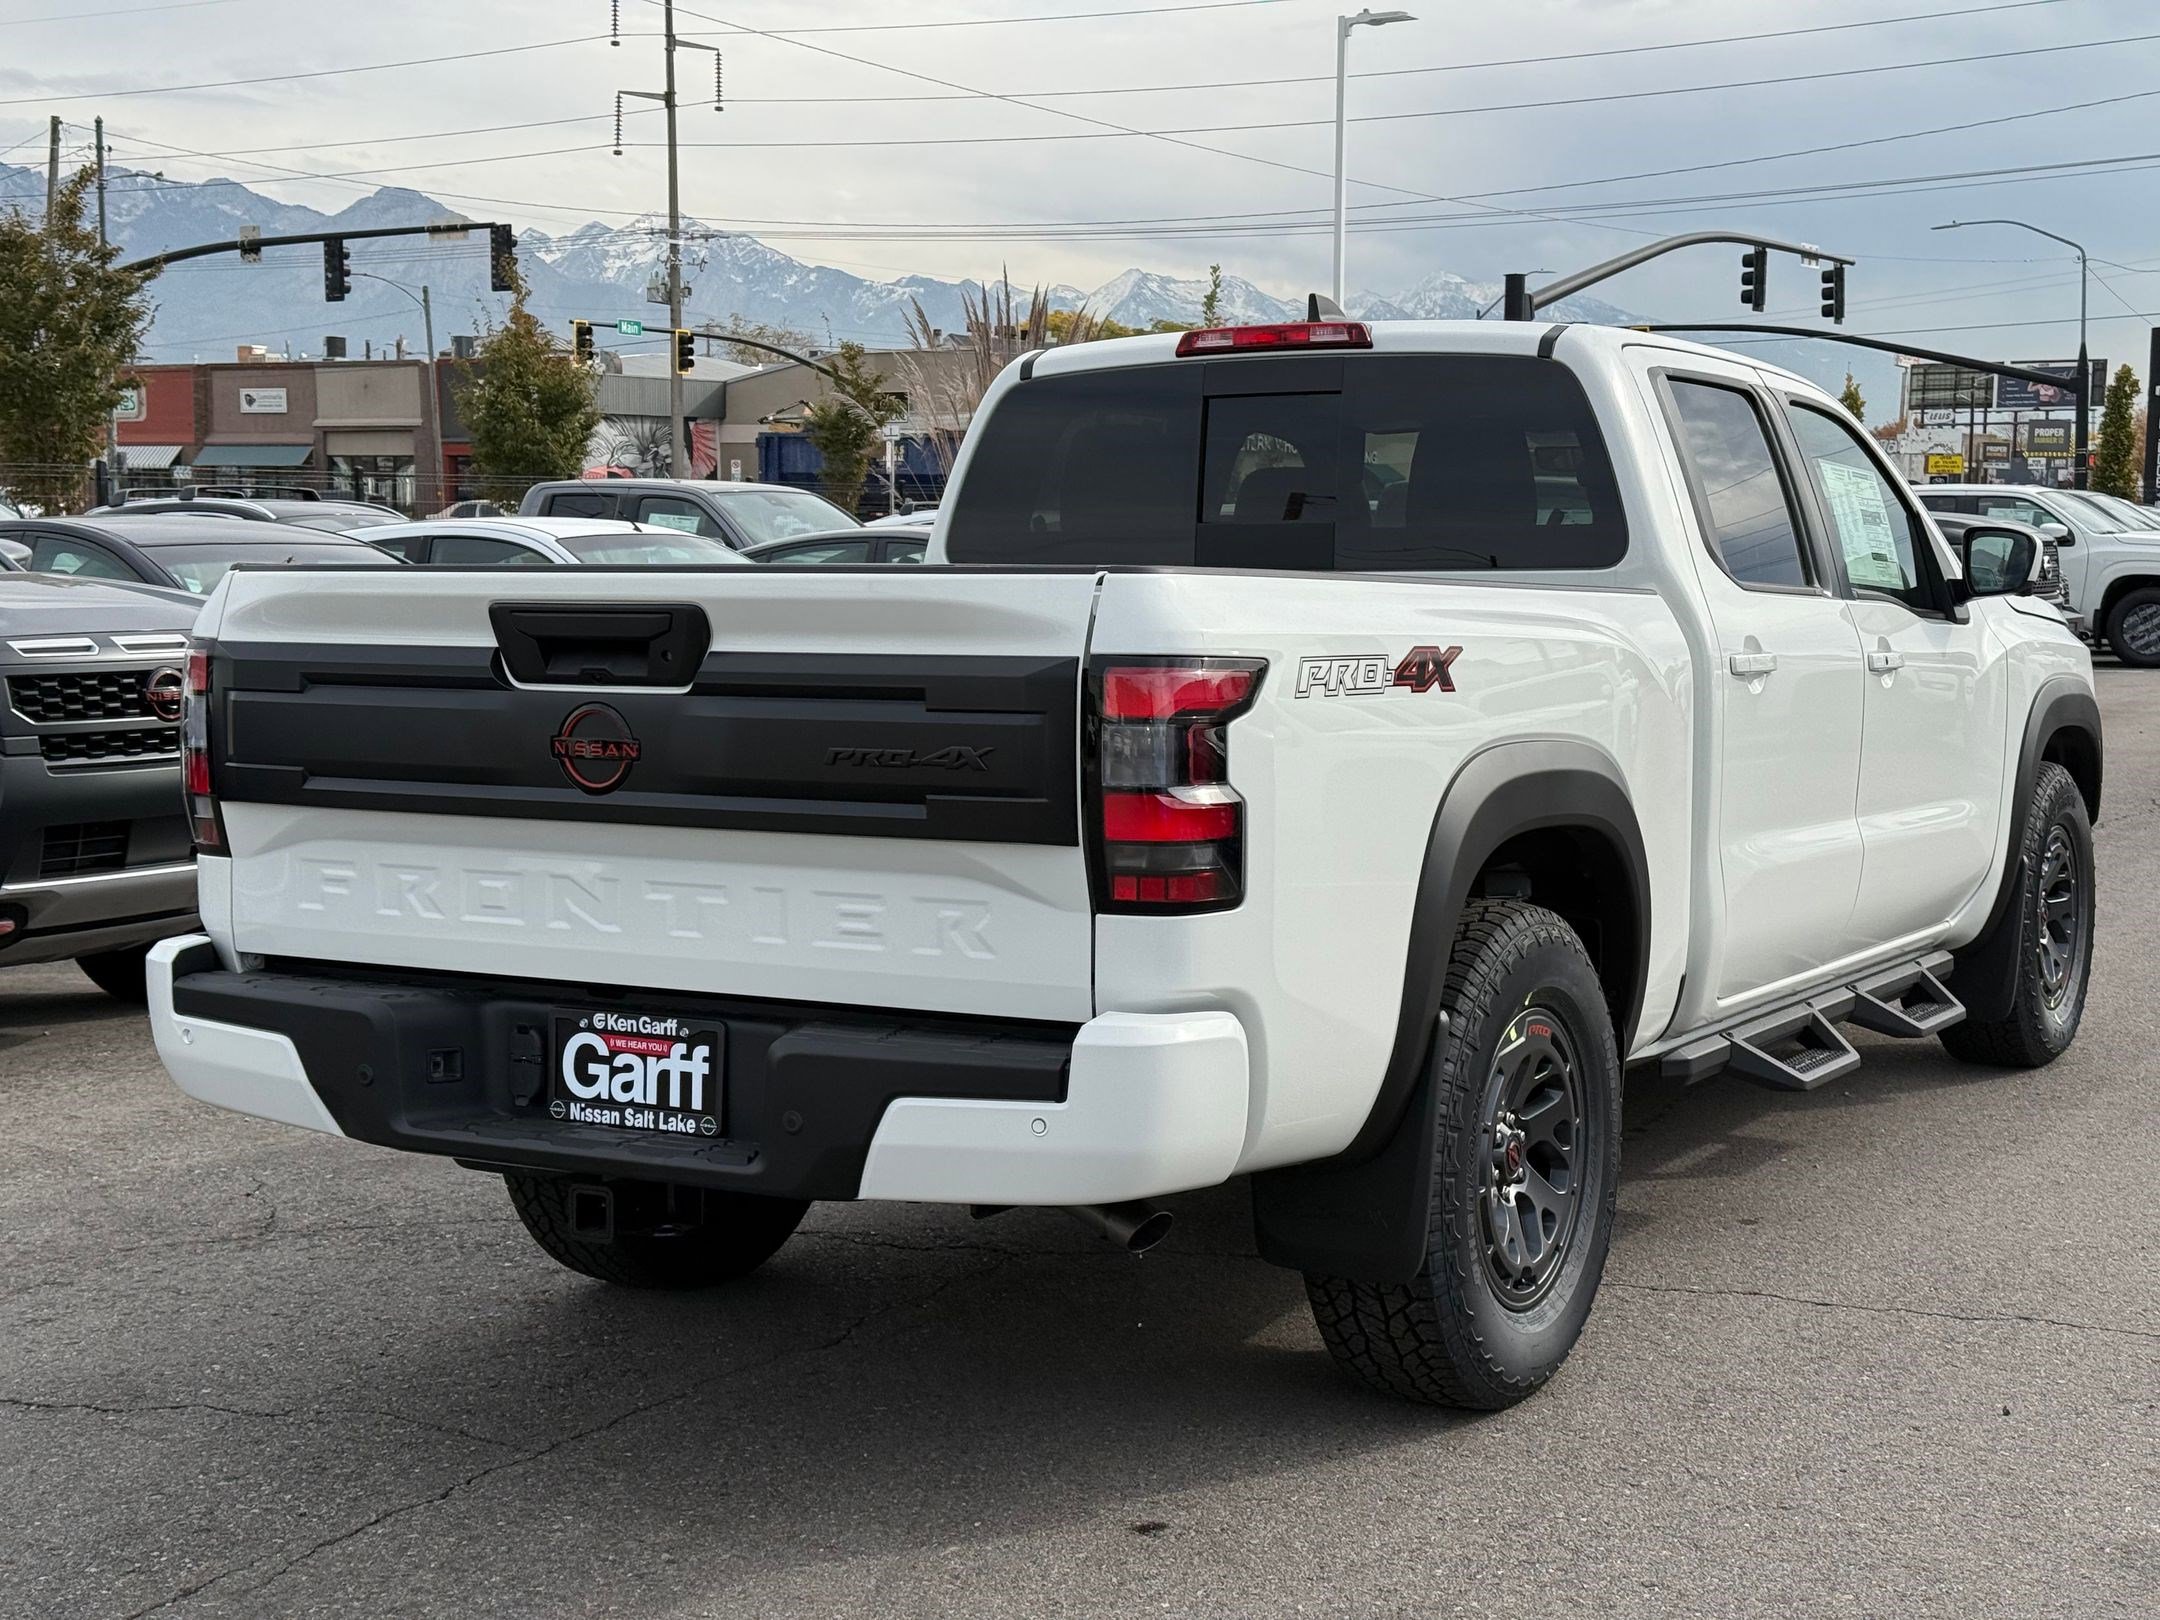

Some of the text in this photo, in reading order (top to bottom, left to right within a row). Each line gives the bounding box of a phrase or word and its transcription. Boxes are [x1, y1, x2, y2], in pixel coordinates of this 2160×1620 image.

[621, 322, 638, 334] Main
[2034, 427, 2065, 437] PROPER
[1295, 646, 1463, 699] PRO-4X
[147, 692, 181, 702] NISS
[553, 740, 640, 759] NISSAN
[824, 746, 995, 772] PRO-4X
[296, 858, 998, 962] FRONTIER
[607, 1014, 678, 1036] Ken Garff
[615, 1040, 663, 1052] WE HEAR YOU
[562, 1031, 710, 1111] Garff
[569, 1102, 697, 1133] Nissan Salt Lake
